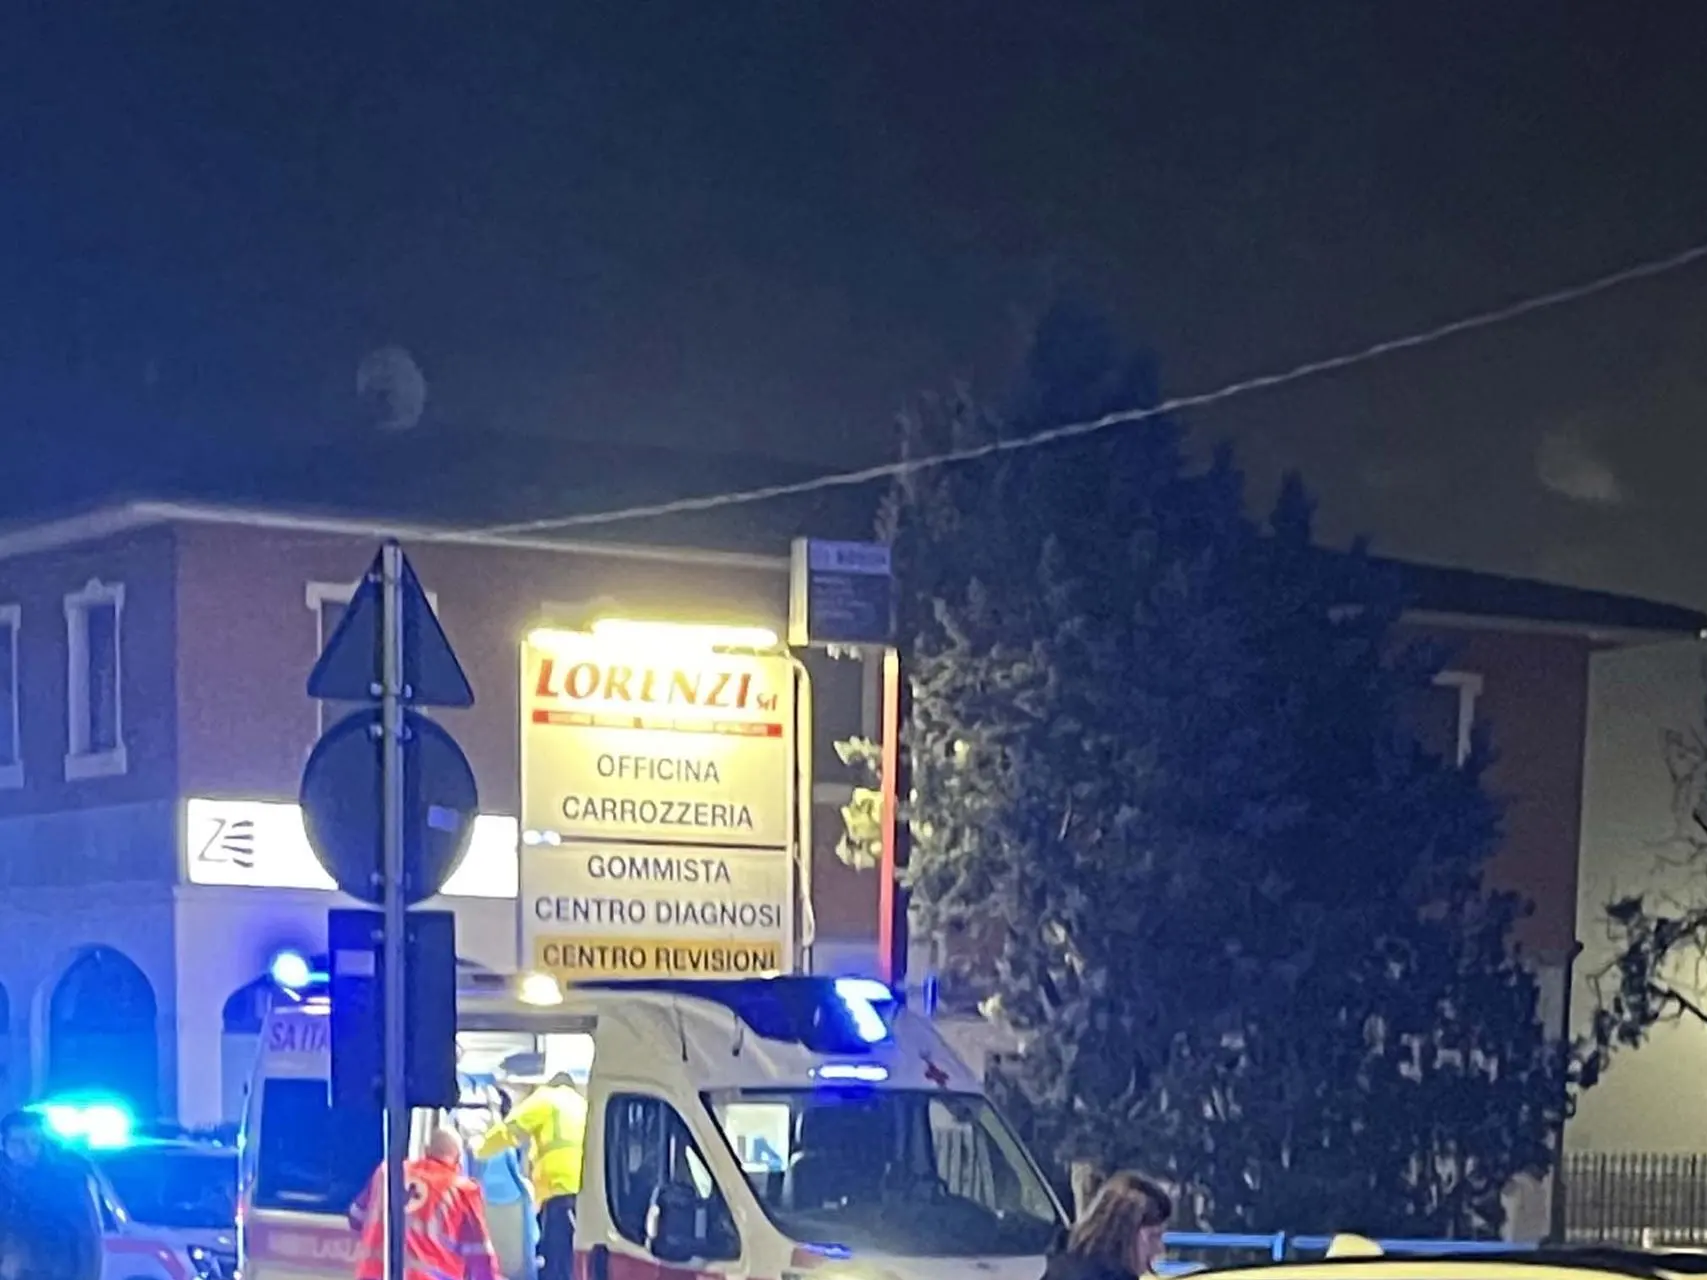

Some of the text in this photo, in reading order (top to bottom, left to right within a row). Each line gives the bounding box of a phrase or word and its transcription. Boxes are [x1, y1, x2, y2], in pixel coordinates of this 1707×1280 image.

[535, 658, 752, 709] LORENZI
[597, 753, 721, 784] OFFICINA
[561, 795, 754, 829] CARROZZERIA
[587, 854, 732, 884] GOMMISTA
[534, 895, 783, 928] CENTRO DIAGNOSI
[542, 943, 777, 973] CENTRO REVISIONI
